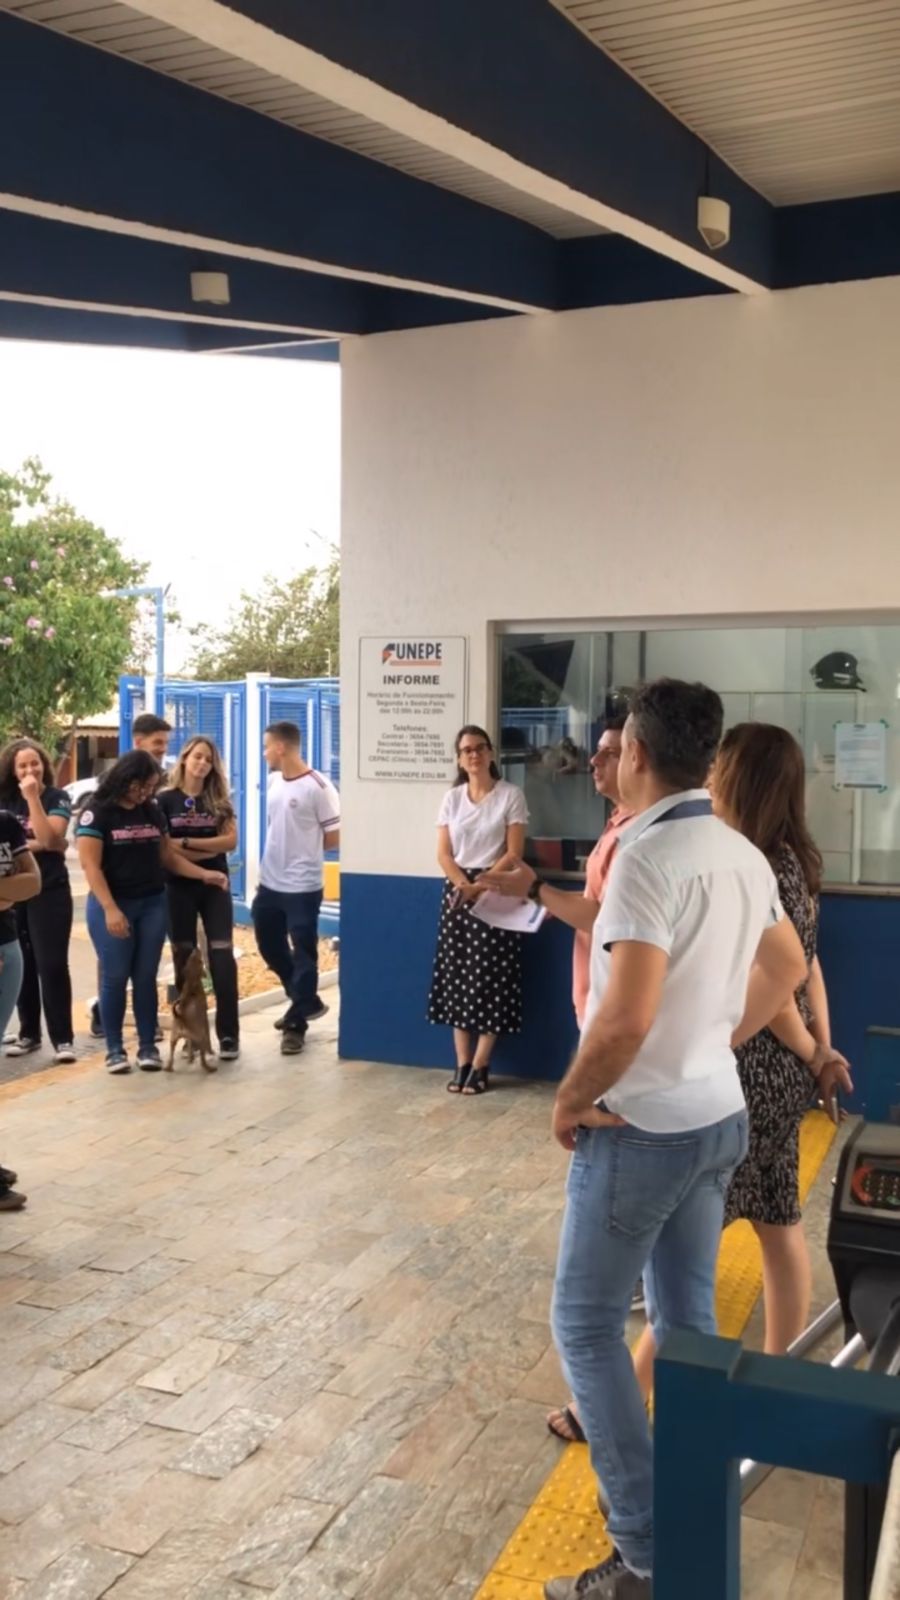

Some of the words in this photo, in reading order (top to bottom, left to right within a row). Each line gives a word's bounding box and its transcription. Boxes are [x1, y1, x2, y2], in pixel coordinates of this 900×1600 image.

[382, 643, 442, 665] FUNEPE
[383, 675, 440, 685] INFORME
[377, 700, 403, 708] Segunda
[375, 771, 447, 779] WWW.FUNEPE.EDU.BR
